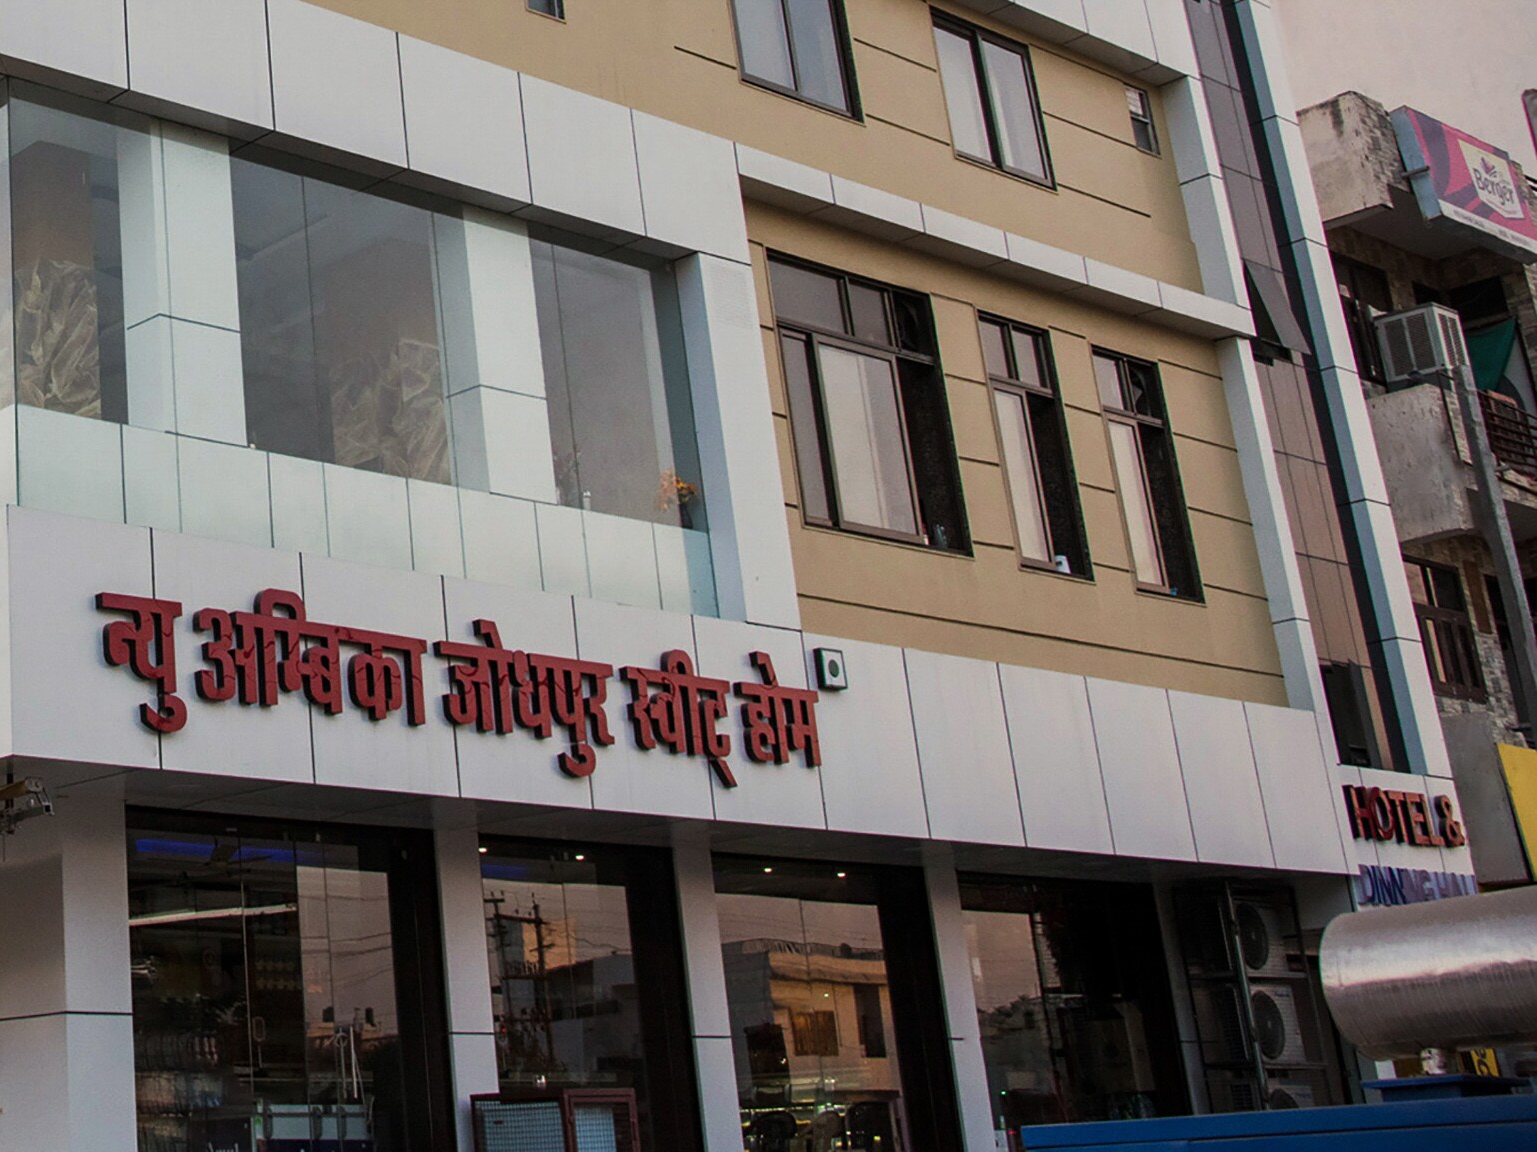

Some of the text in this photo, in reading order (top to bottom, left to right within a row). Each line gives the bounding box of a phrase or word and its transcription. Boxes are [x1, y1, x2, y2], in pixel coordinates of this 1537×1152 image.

[1472, 168, 1515, 206] Berger
[192, 588, 427, 726] अम्बिका
[434, 618, 614, 778] जोधपुर
[733, 650, 822, 767] होम
[1342, 784, 1465, 848] HOTEL &
